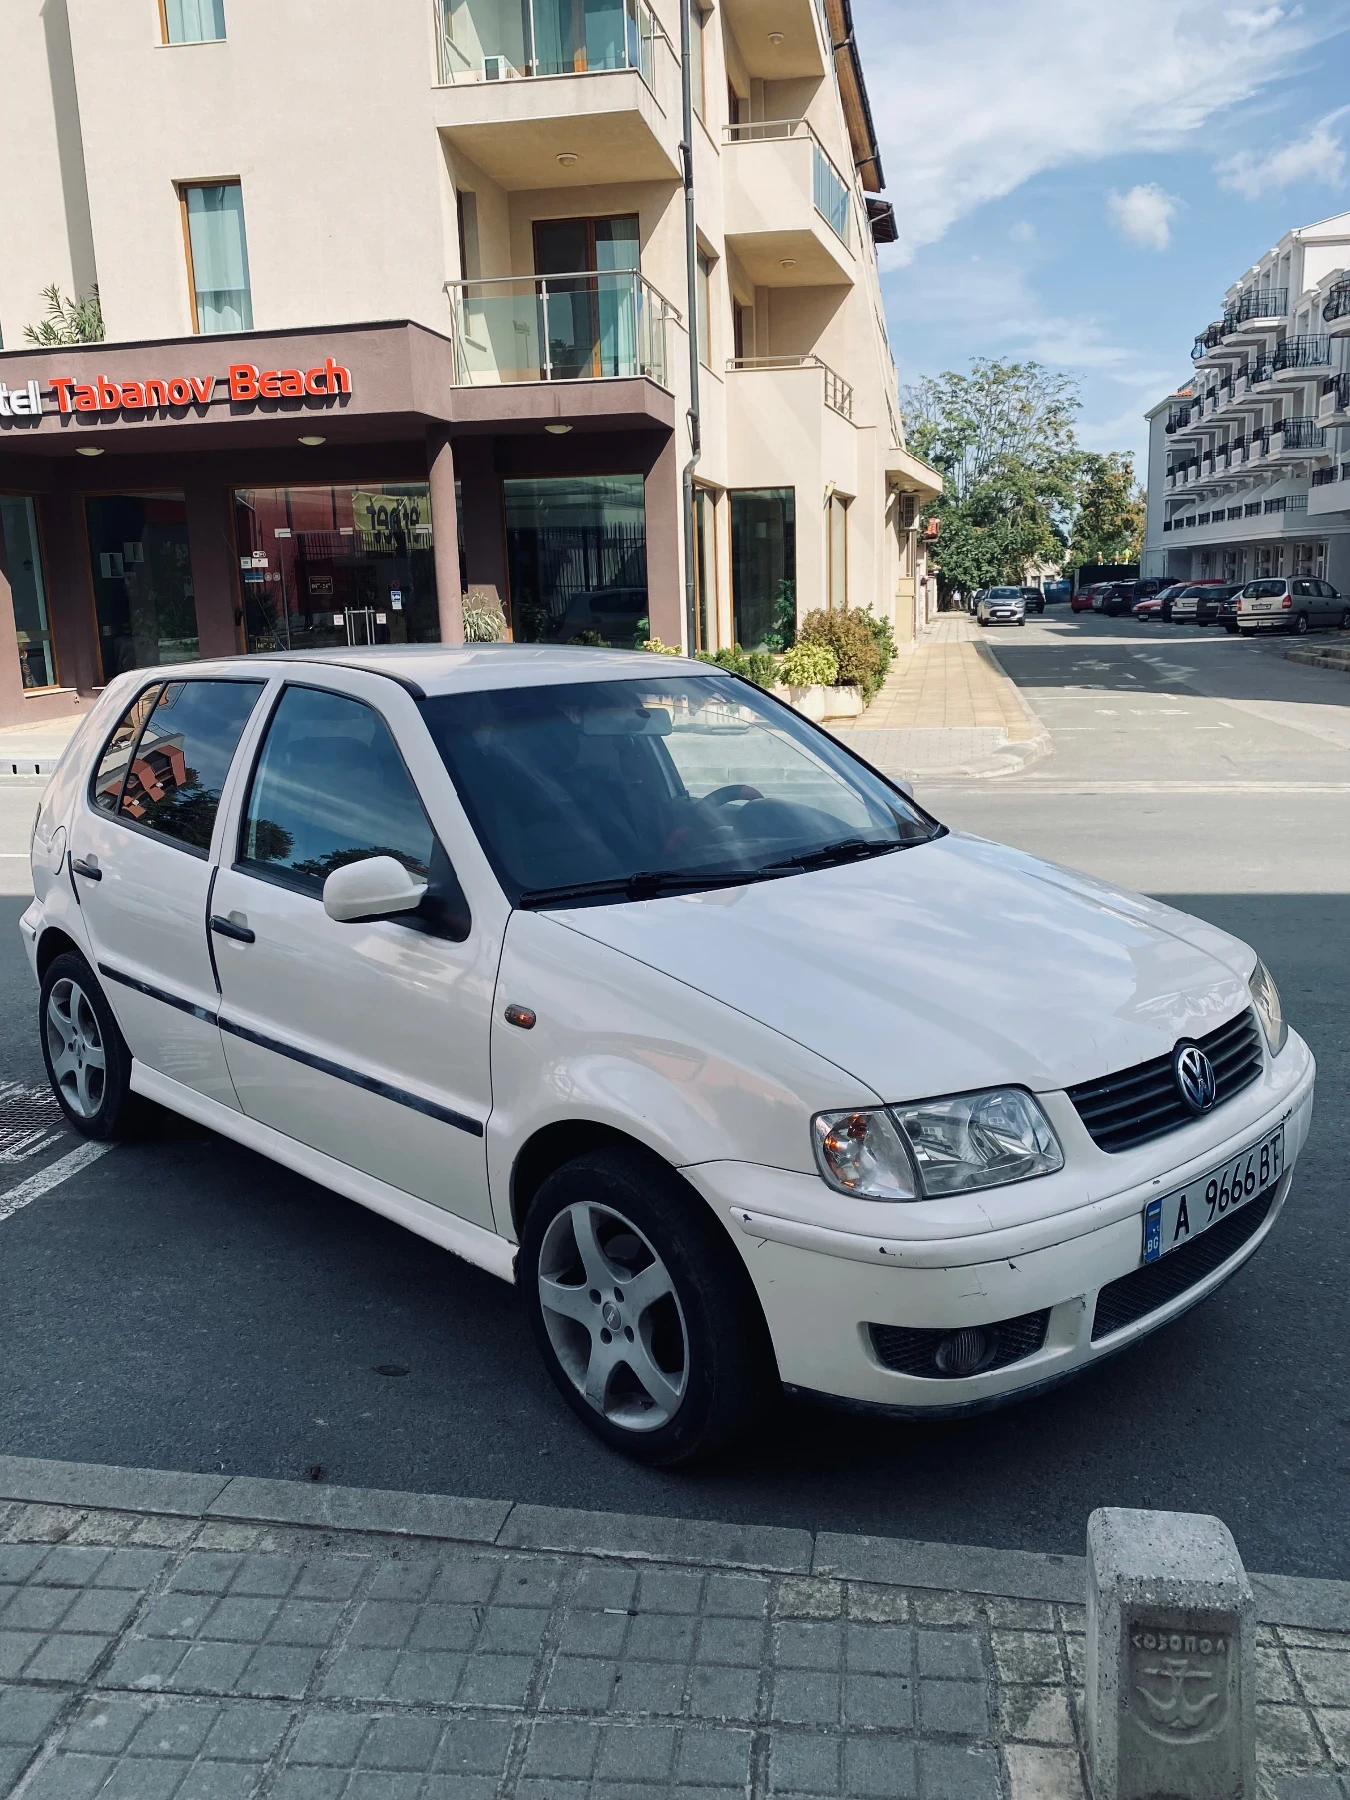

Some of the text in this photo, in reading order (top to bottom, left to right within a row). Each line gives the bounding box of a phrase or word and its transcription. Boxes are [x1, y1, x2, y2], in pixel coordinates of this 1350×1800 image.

[49, 375, 216, 413] Tabanov
[229, 357, 352, 401] Beach
[1173, 1194, 1190, 1241] A
[1205, 1155, 1256, 1223] 9666
[1147, 1236, 1159, 1253] BG
